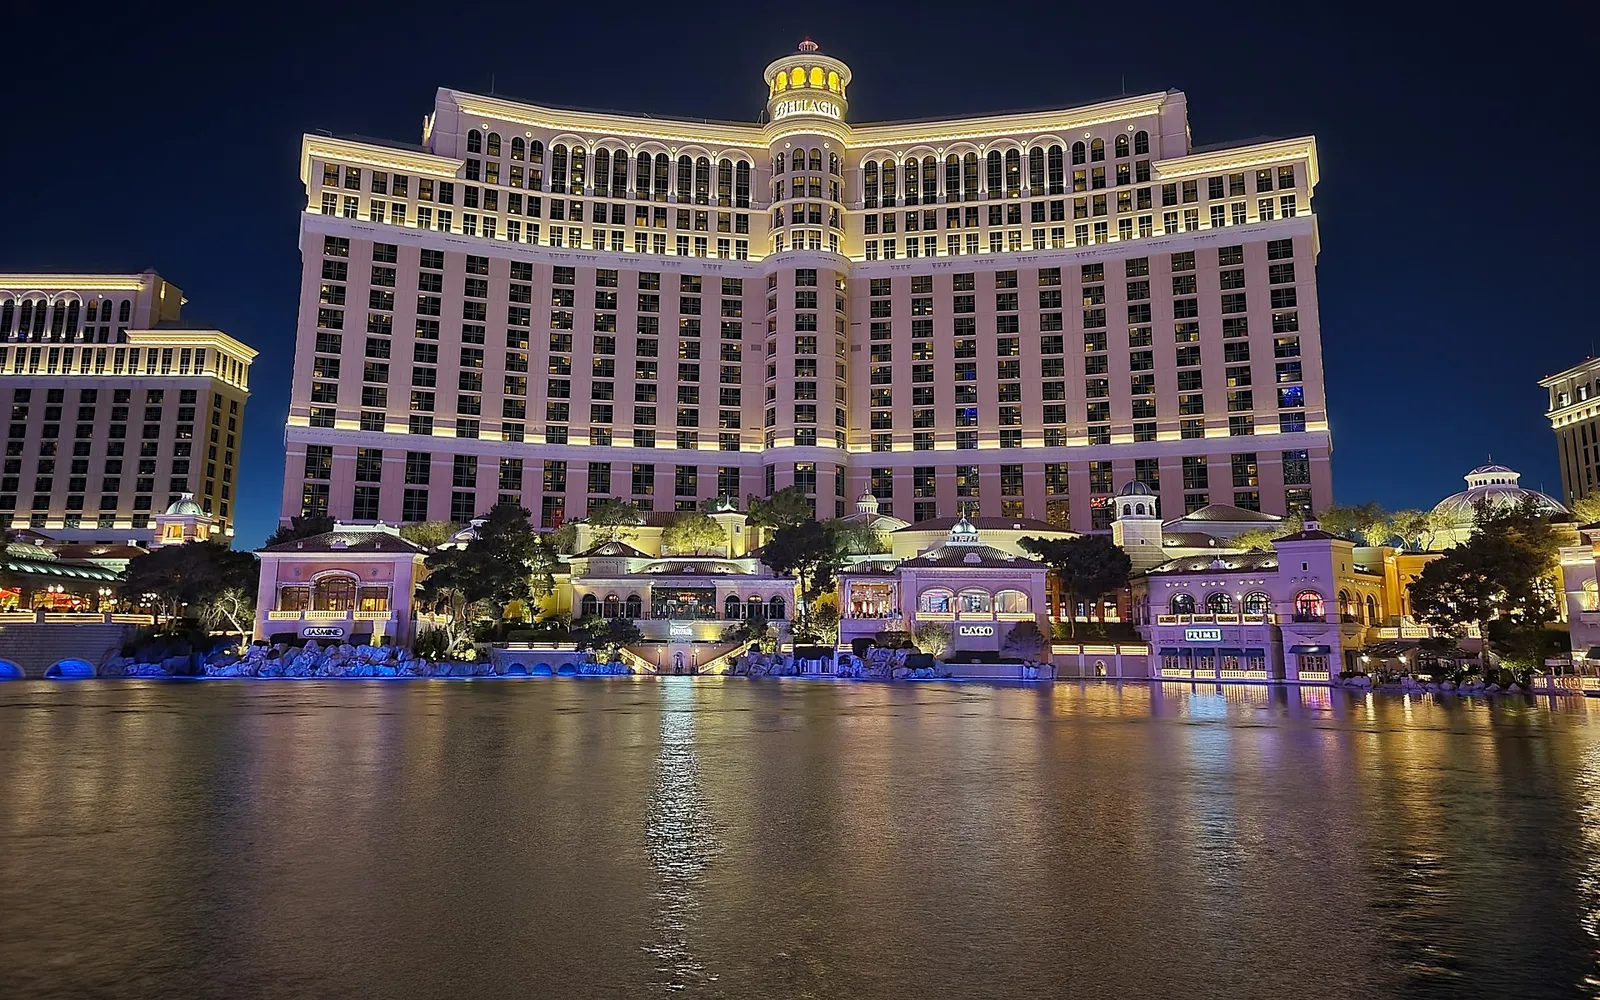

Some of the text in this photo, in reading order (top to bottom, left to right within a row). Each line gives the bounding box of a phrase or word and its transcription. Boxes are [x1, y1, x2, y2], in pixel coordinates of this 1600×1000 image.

[775, 99, 840, 118] BELLAGIO
[305, 628, 341, 636] JASMINE
[960, 626, 993, 635] LAGO
[1187, 630, 1218, 639] PRIME
